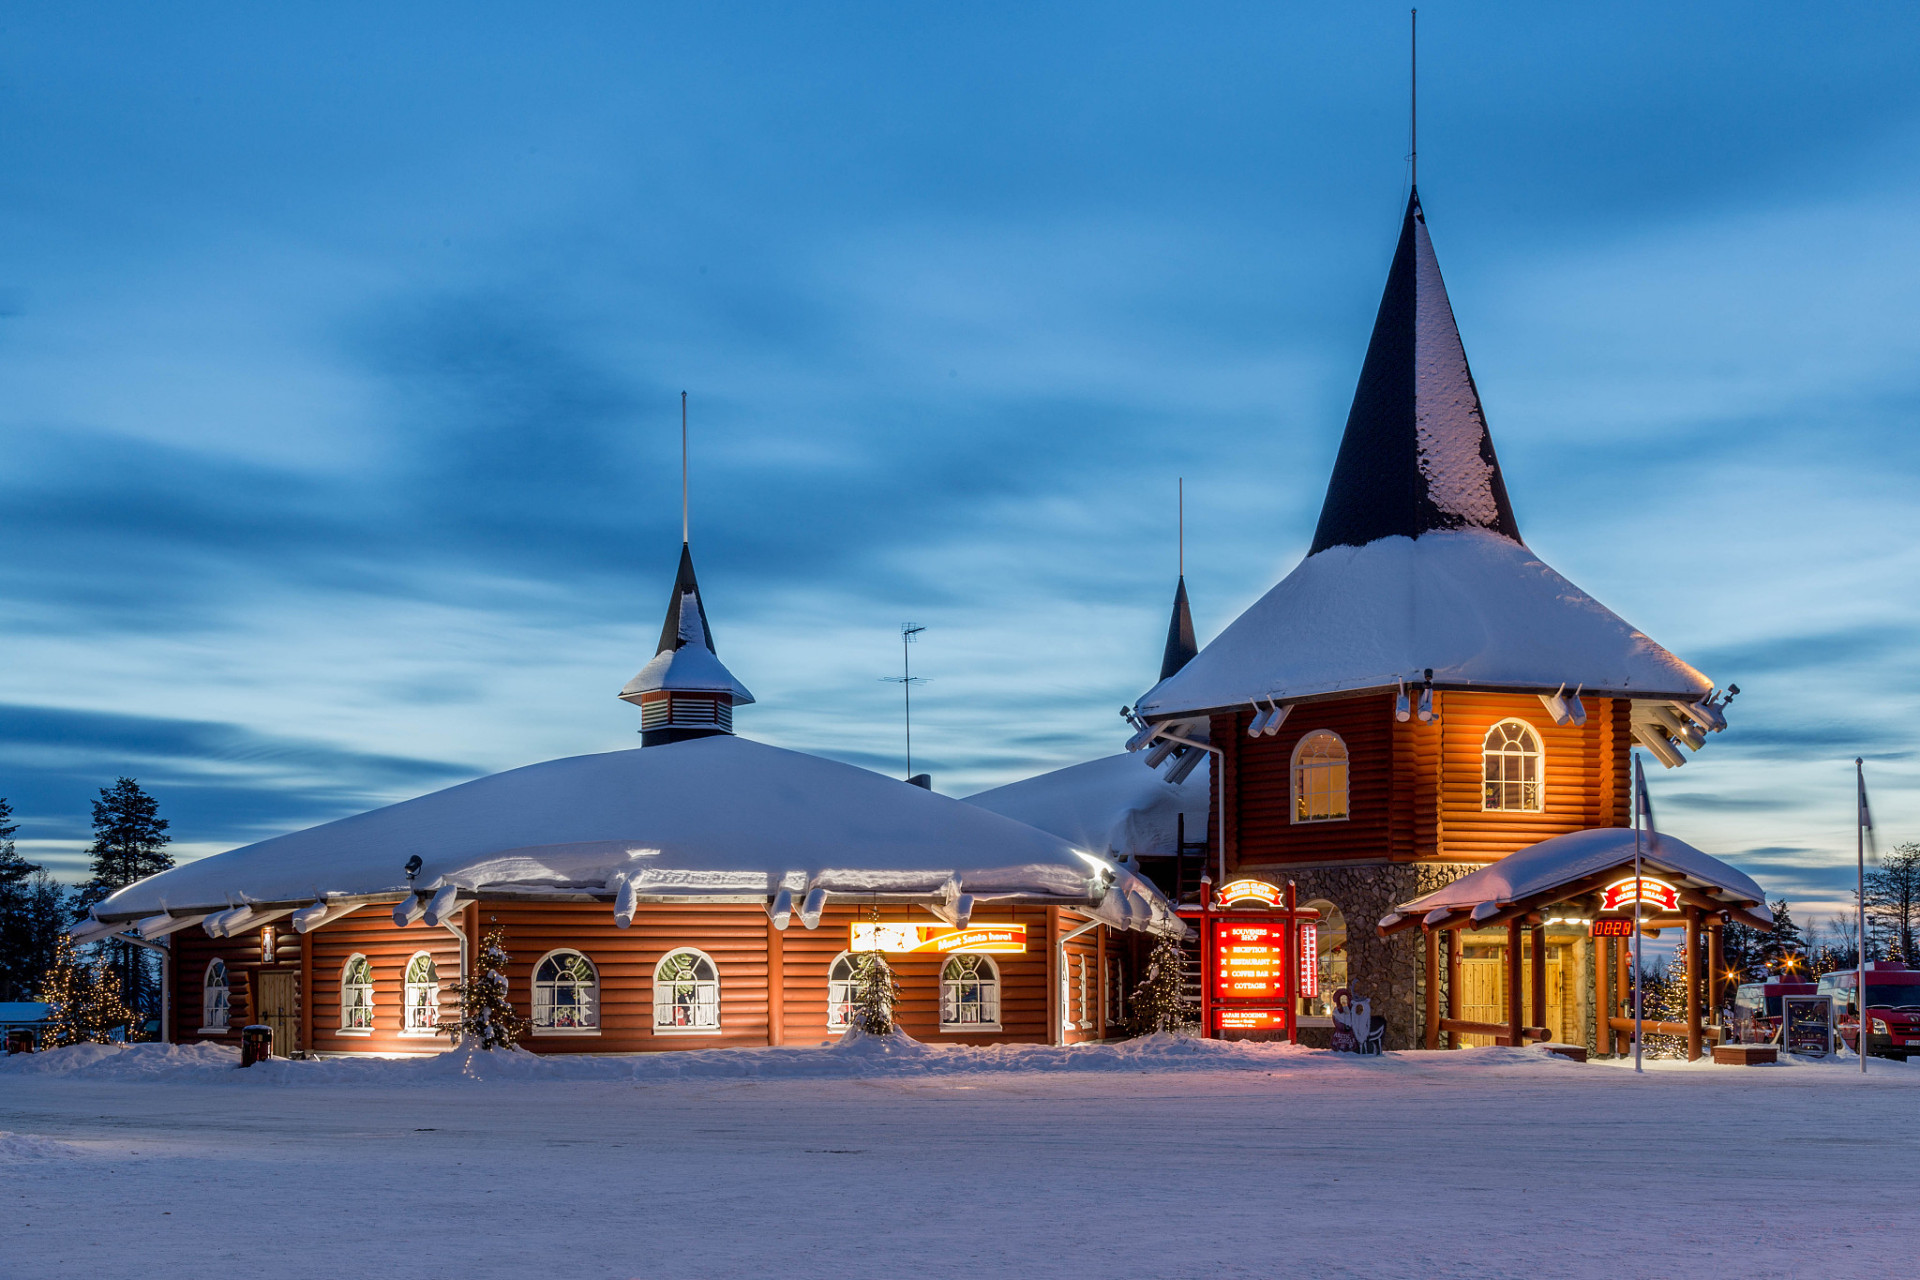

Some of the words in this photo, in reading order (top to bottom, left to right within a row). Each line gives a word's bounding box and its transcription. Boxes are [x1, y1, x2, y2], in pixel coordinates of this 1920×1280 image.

[1621, 883, 1636, 892] SANT
[938, 938, 961, 951] Meet
[962, 934, 987, 944] Santa
[988, 932, 1012, 941] here!
